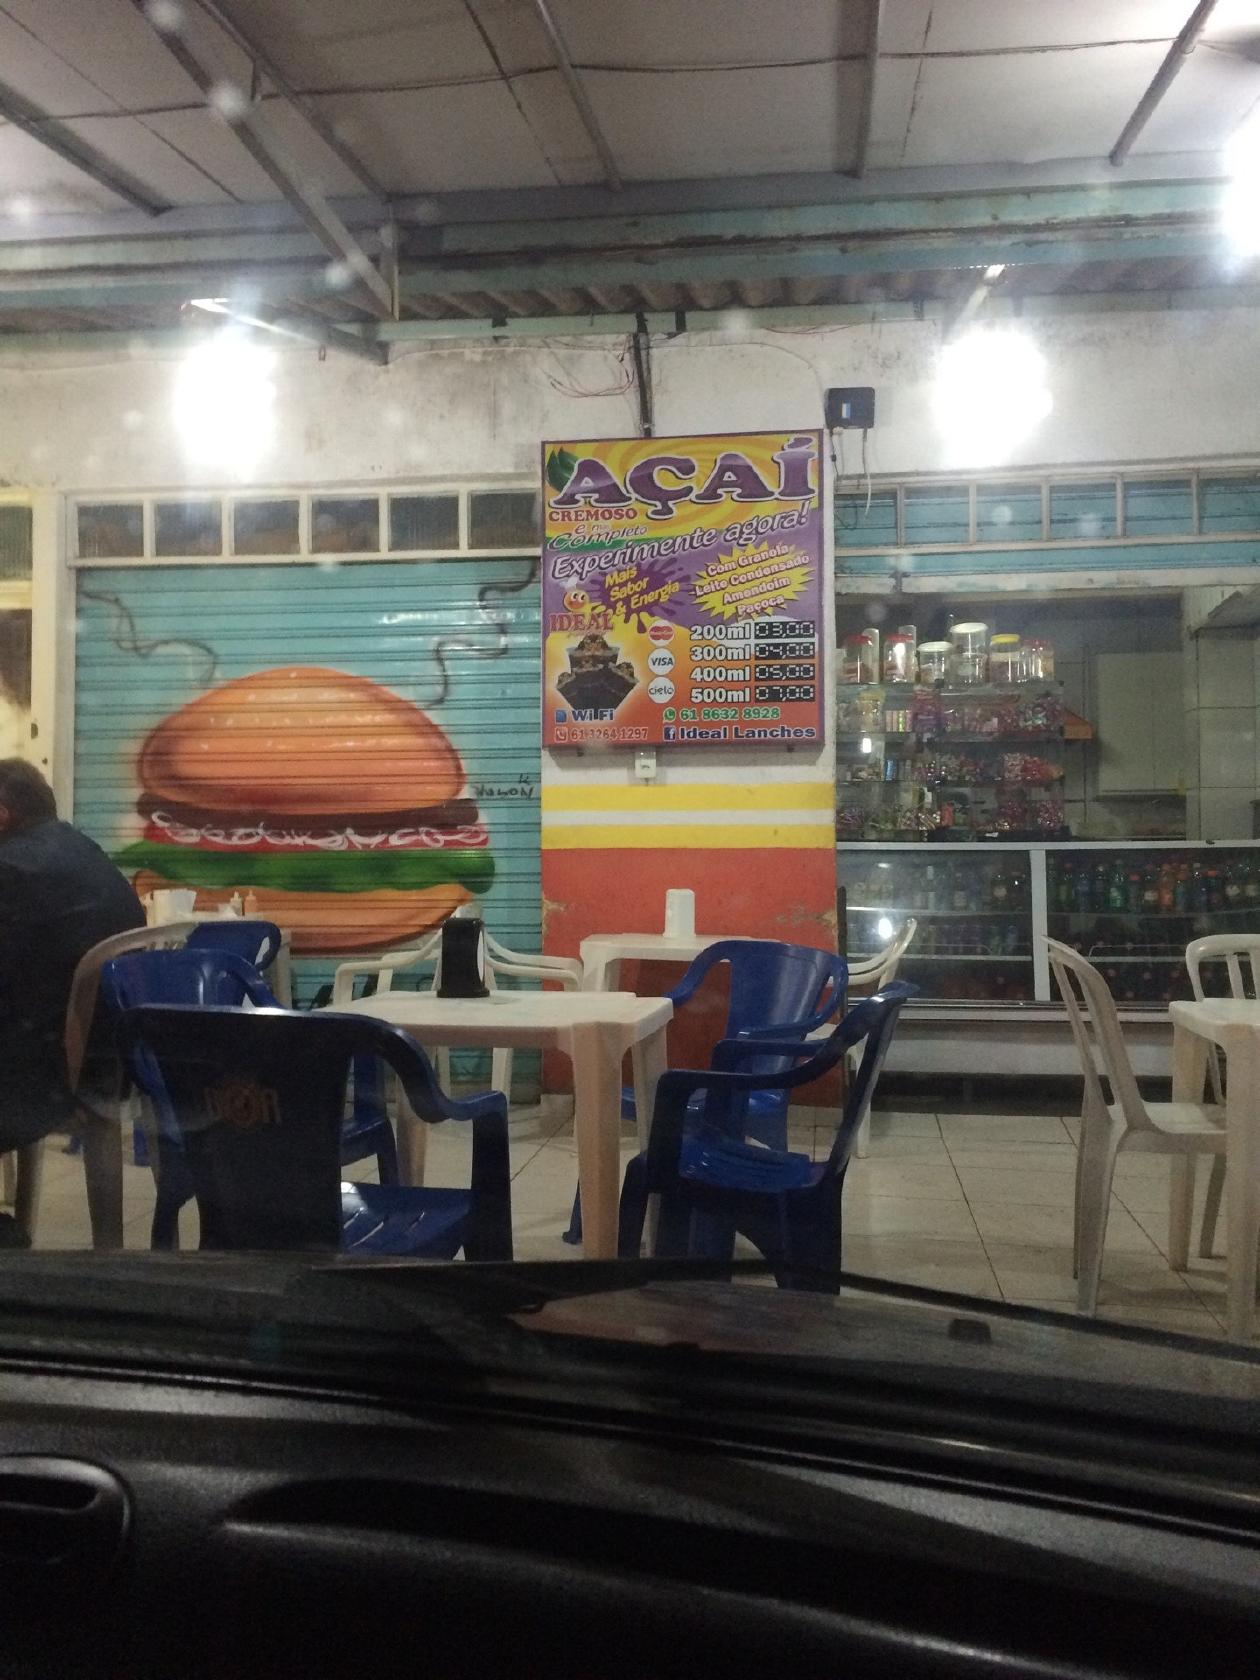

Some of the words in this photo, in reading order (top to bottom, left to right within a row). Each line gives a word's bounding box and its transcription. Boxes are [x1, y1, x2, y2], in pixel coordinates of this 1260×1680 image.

[548, 436, 817, 519] AÇAÍ
[548, 508, 638, 522] CREMOSO
[548, 525, 647, 551] Completo
[552, 530, 718, 580] Experimente
[722, 501, 812, 545] agora!
[605, 567, 638, 588] Mais
[695, 580, 728, 597] Leite
[730, 554, 810, 585] Condensado
[707, 562, 738, 577] Com
[610, 576, 649, 601] Sabor
[723, 577, 791, 605] Amendoim
[615, 600, 627, 616] &
[631, 580, 680, 608] Energia
[737, 594, 785, 616] Paçoca
[549, 613, 614, 632] IDEAL
[690, 622, 752, 640] 200ml
[756, 622, 813, 637] 03,00
[690, 644, 752, 661] 300ml
[756, 643, 813, 659] 04,00
[651, 657, 674, 666] VISA
[690, 666, 752, 682] 400ml
[756, 664, 813, 680] 05,00
[648, 685, 674, 695] cielo
[690, 687, 752, 703] 500ml
[756, 685, 813, 701] 07,00
[680, 709, 697, 720] 61
[703, 708, 739, 720] 8632
[743, 707, 779, 719] 8928
[680, 727, 728, 739] Ideal
[734, 726, 815, 739] Lanches
